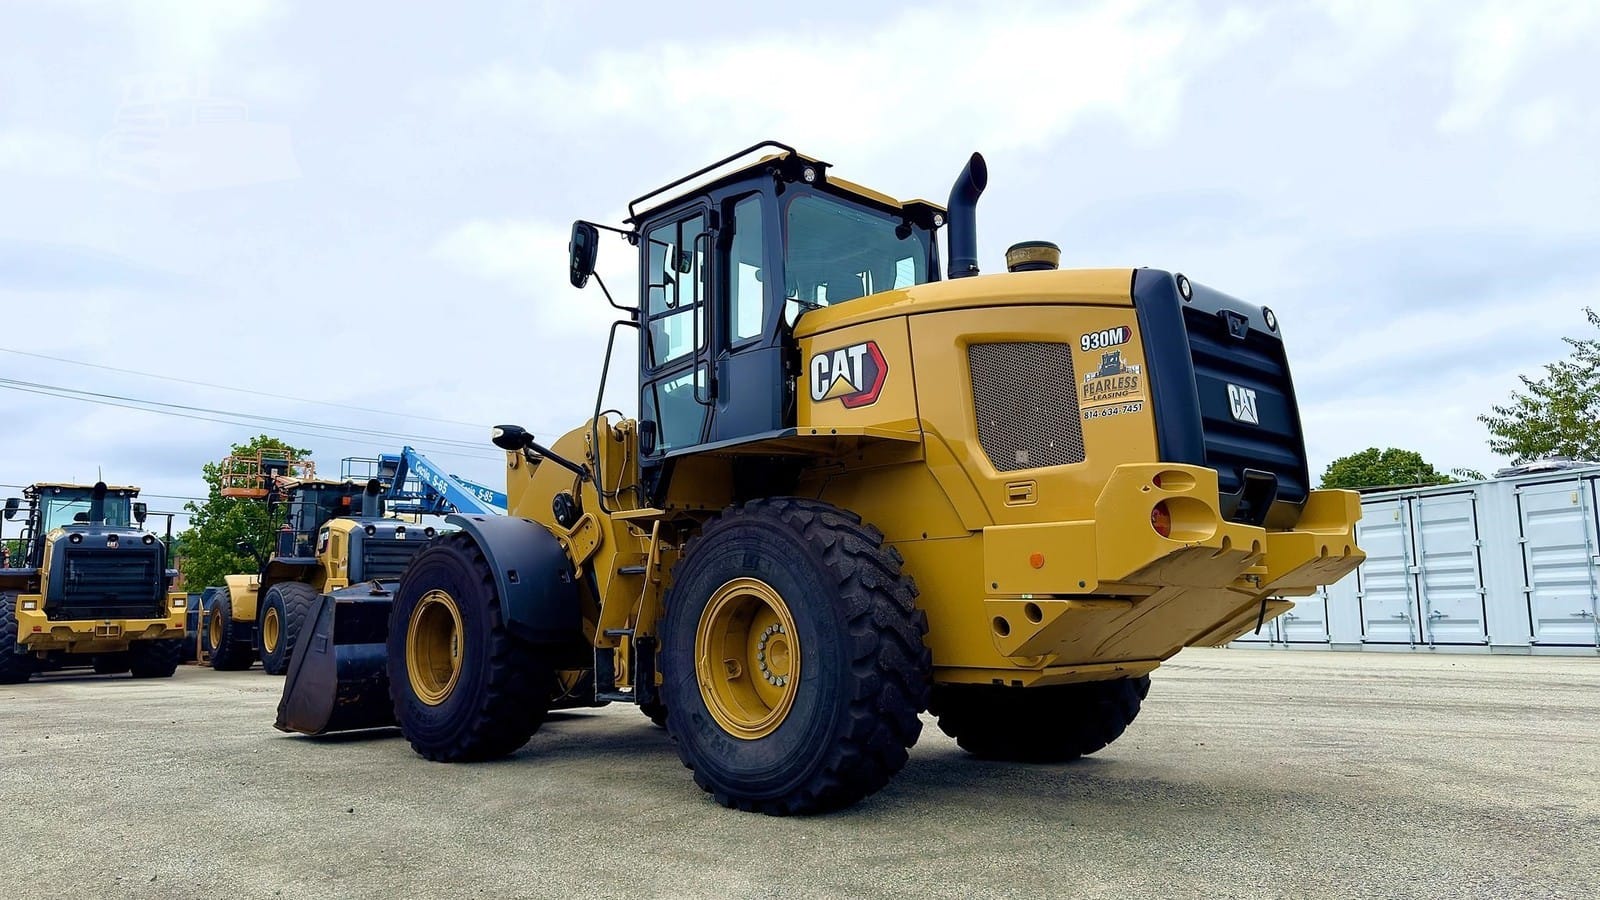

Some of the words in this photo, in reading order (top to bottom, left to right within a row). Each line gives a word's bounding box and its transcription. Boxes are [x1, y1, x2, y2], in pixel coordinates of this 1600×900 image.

[1081, 327, 1123, 351] 930M
[810, 343, 868, 401] CAT
[1083, 376, 1138, 398] FEARLESS
[1093, 390, 1129, 401] LEASING
[1227, 383, 1259, 425] CAT
[432, 475, 448, 495] S-65
[478, 488, 494, 503] S-85
